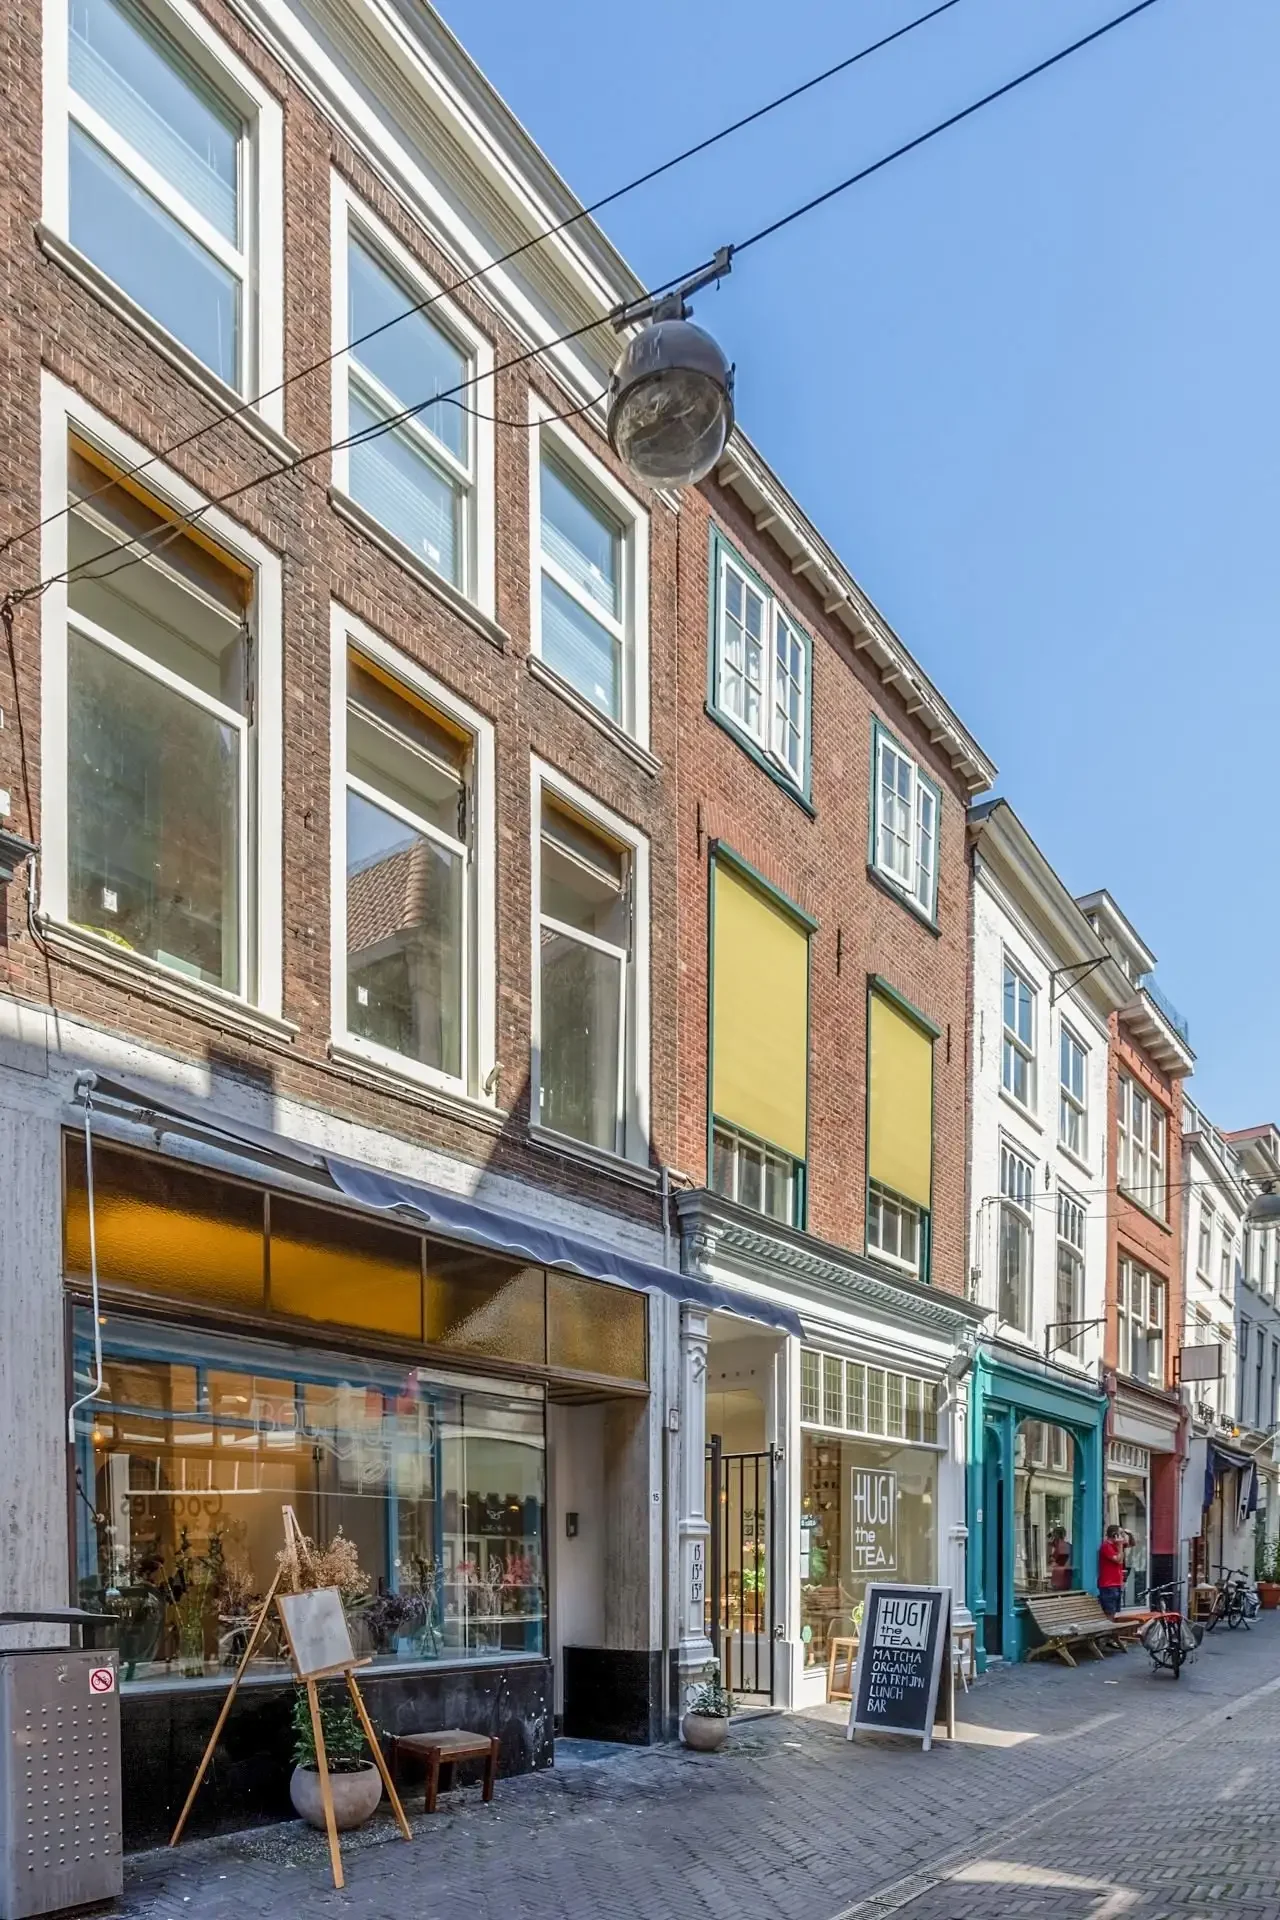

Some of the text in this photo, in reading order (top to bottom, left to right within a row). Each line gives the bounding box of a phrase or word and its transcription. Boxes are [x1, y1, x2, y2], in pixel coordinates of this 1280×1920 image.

[653, 1493, 659, 1502] 15
[855, 1526, 876, 1543] the
[855, 1545, 886, 1566] TEA
[881, 1625, 903, 1635] the
[880, 1634, 912, 1647] TEA
[873, 1649, 922, 1664] MATCHA
[872, 1661, 918, 1675] ORGANIC
[870, 1672, 925, 1689] TEA FRM JPN
[869, 1685, 904, 1700] LUNCH
[867, 1698, 887, 1713] BAR
